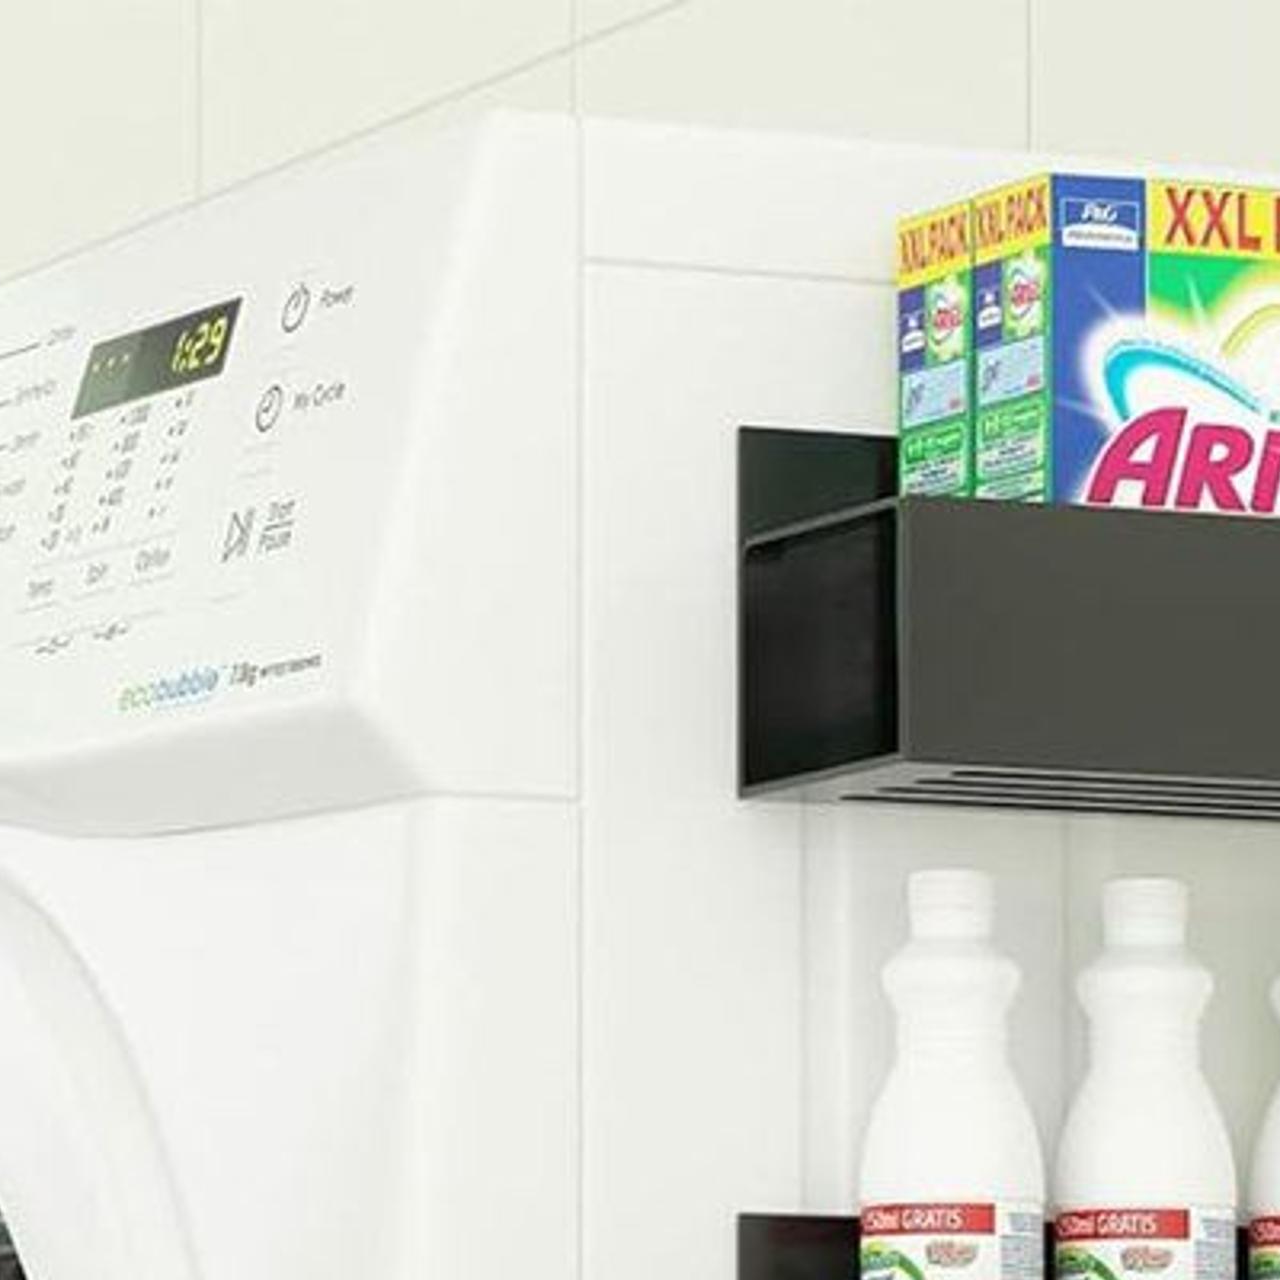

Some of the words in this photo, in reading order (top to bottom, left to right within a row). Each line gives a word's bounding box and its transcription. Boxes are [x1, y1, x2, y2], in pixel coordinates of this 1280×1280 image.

[1007, 188, 1047, 237] PACK
[1165, 187, 1261, 252] XXL
[171, 314, 228, 373] 1:29
[901, 1208, 964, 1230] GRATIS
[1097, 1213, 1156, 1236] GRATIS
